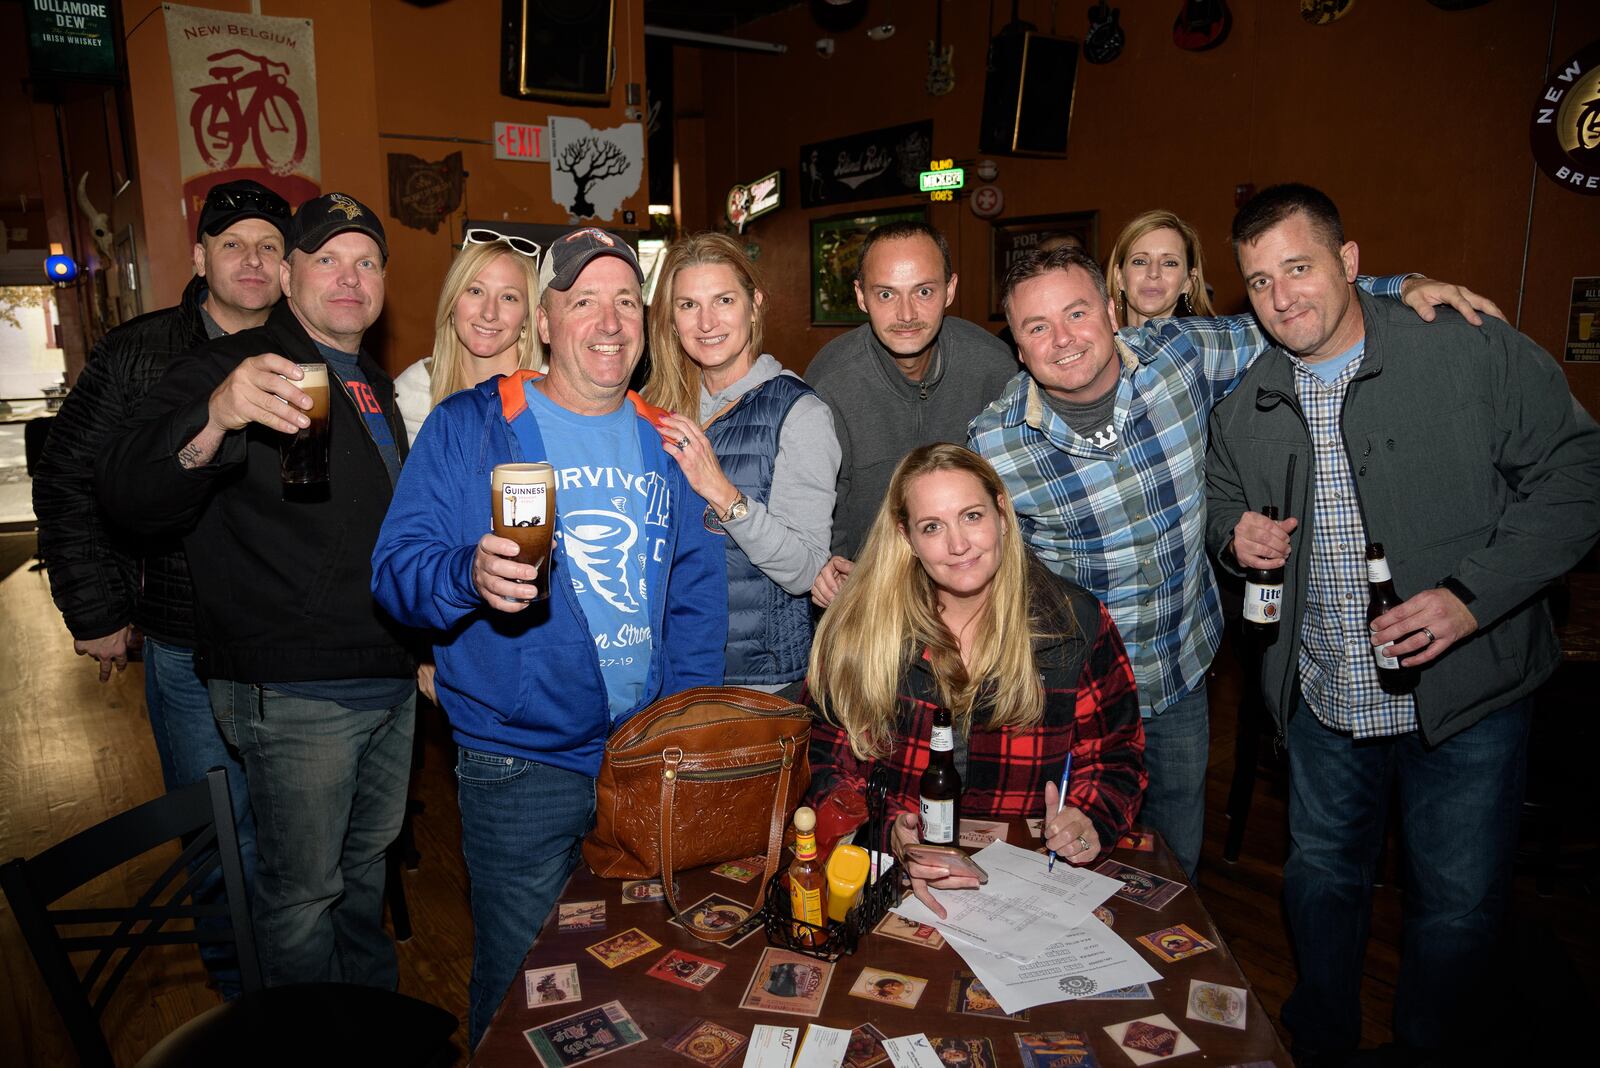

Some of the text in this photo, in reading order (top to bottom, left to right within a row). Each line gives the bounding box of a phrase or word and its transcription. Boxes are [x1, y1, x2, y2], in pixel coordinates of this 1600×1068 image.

[56, 14, 85, 29] DEW
[43, 33, 102, 47] IRISH WHISKEY
[183, 25, 297, 48] NEW BELGIUM
[1537, 60, 1582, 124] NEW
[505, 125, 542, 158] EXIT
[1013, 233, 1039, 249] FOR
[504, 485, 546, 495] GUINNESS
[1260, 588, 1281, 602] Lite
